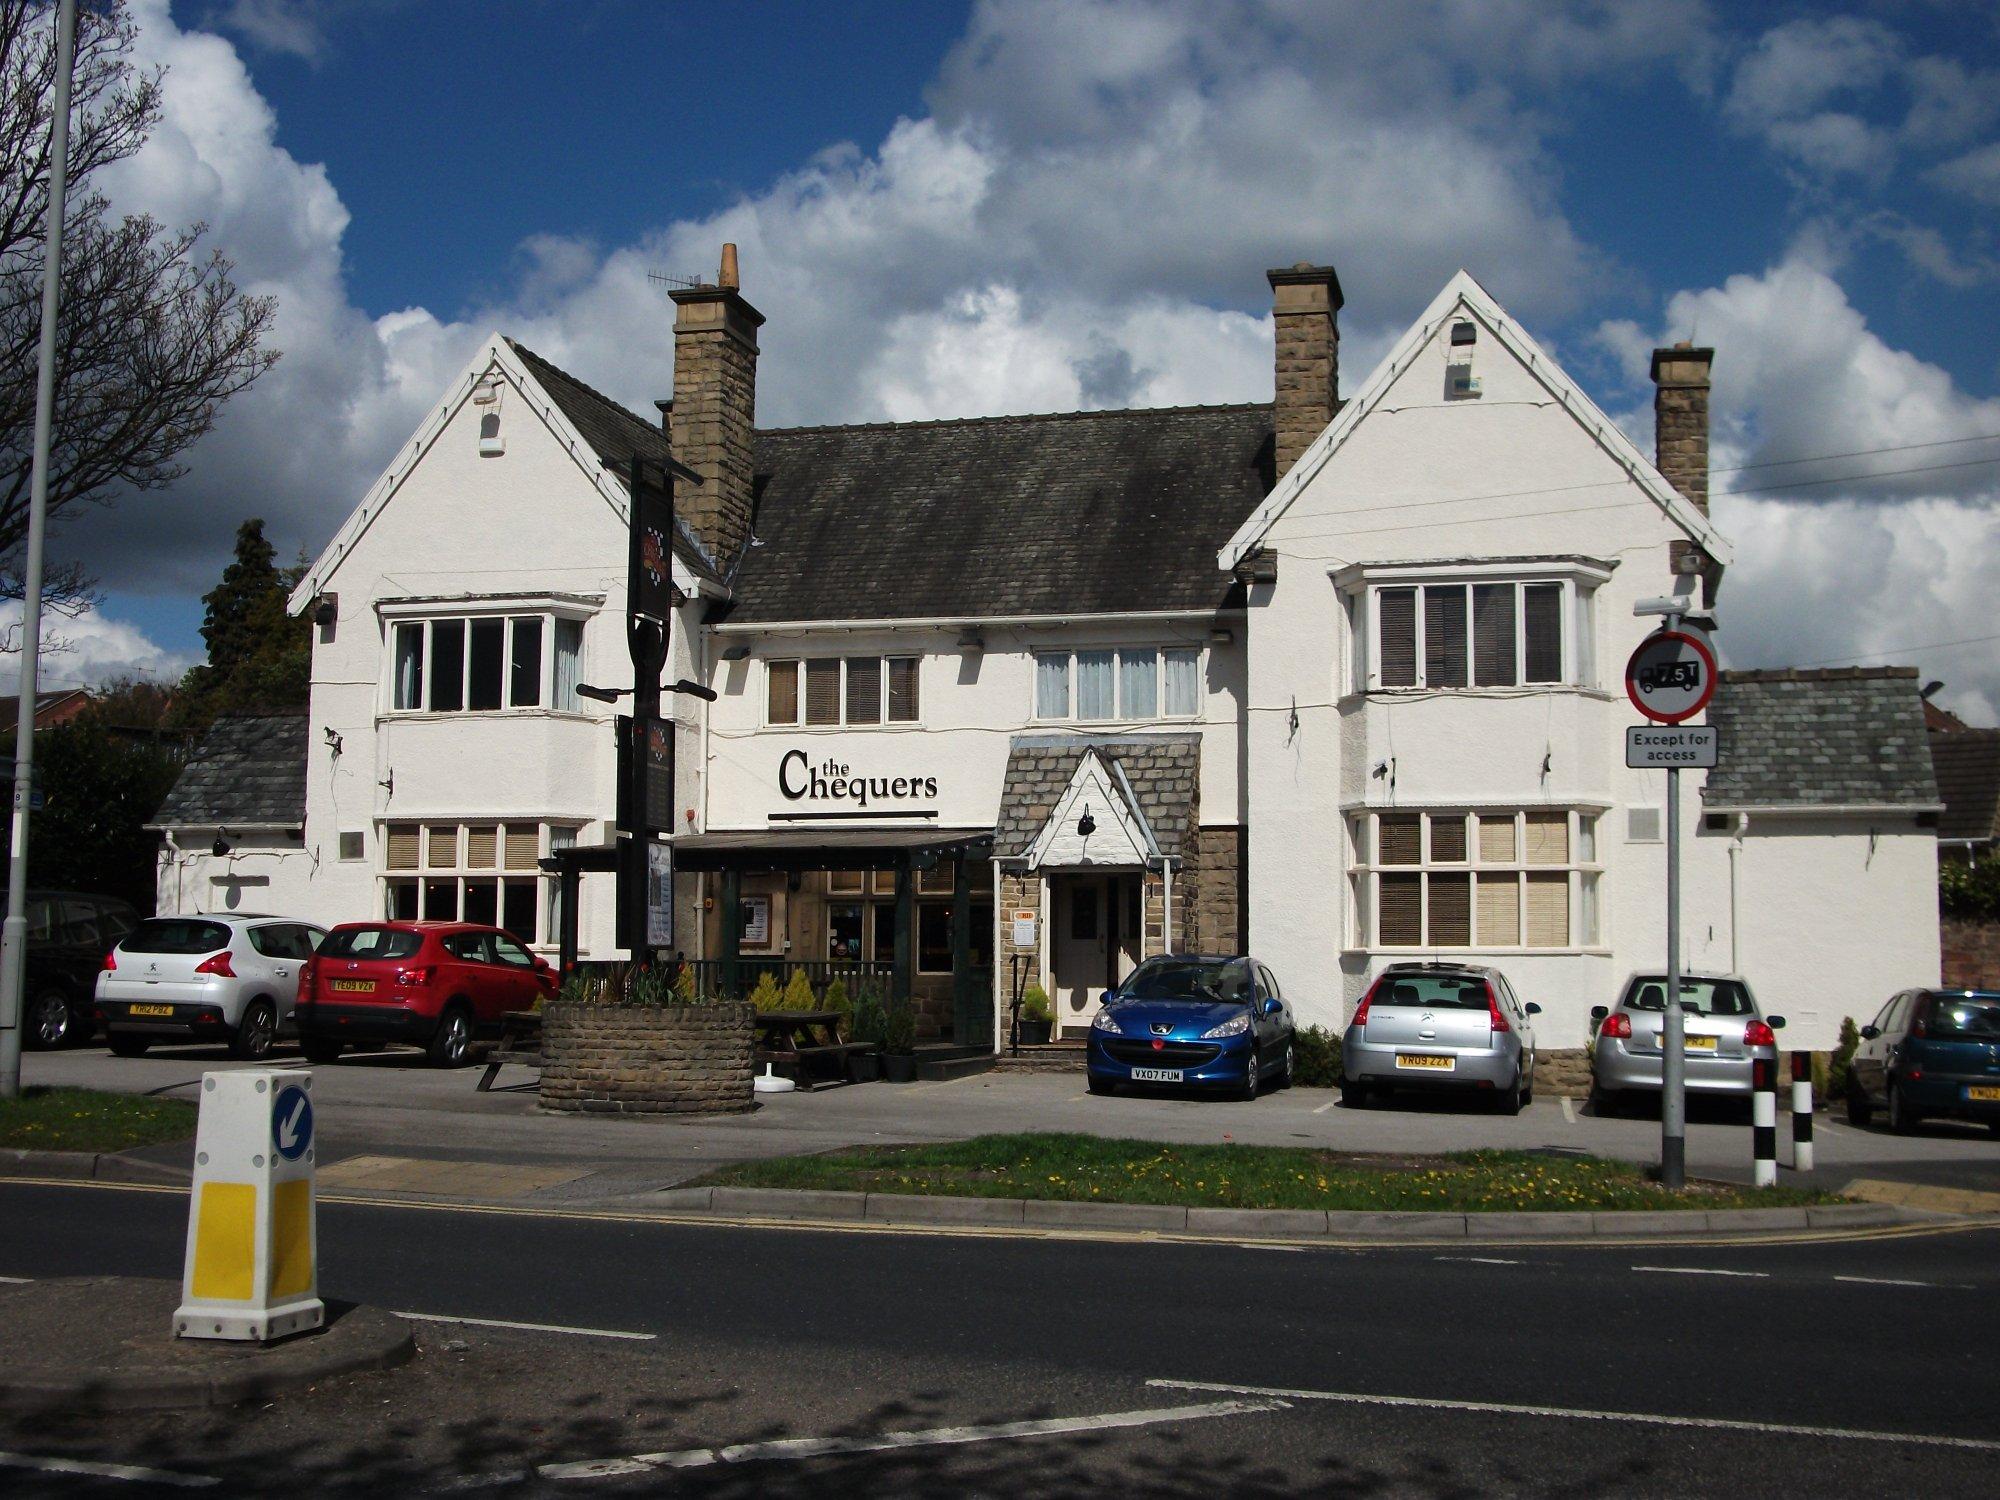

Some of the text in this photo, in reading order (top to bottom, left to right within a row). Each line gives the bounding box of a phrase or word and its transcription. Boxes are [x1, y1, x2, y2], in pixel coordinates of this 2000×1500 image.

[1634, 733, 1710, 747] Except for
[1647, 750, 1696, 761] access
[822, 758, 850, 776] the
[778, 749, 938, 807] Chequers
[336, 979, 357, 990] YE09
[135, 1004, 152, 1013] YR12
[1402, 1055, 1449, 1067] YR09 ZZX
[1135, 1069, 1180, 1081] VX07 FUM
